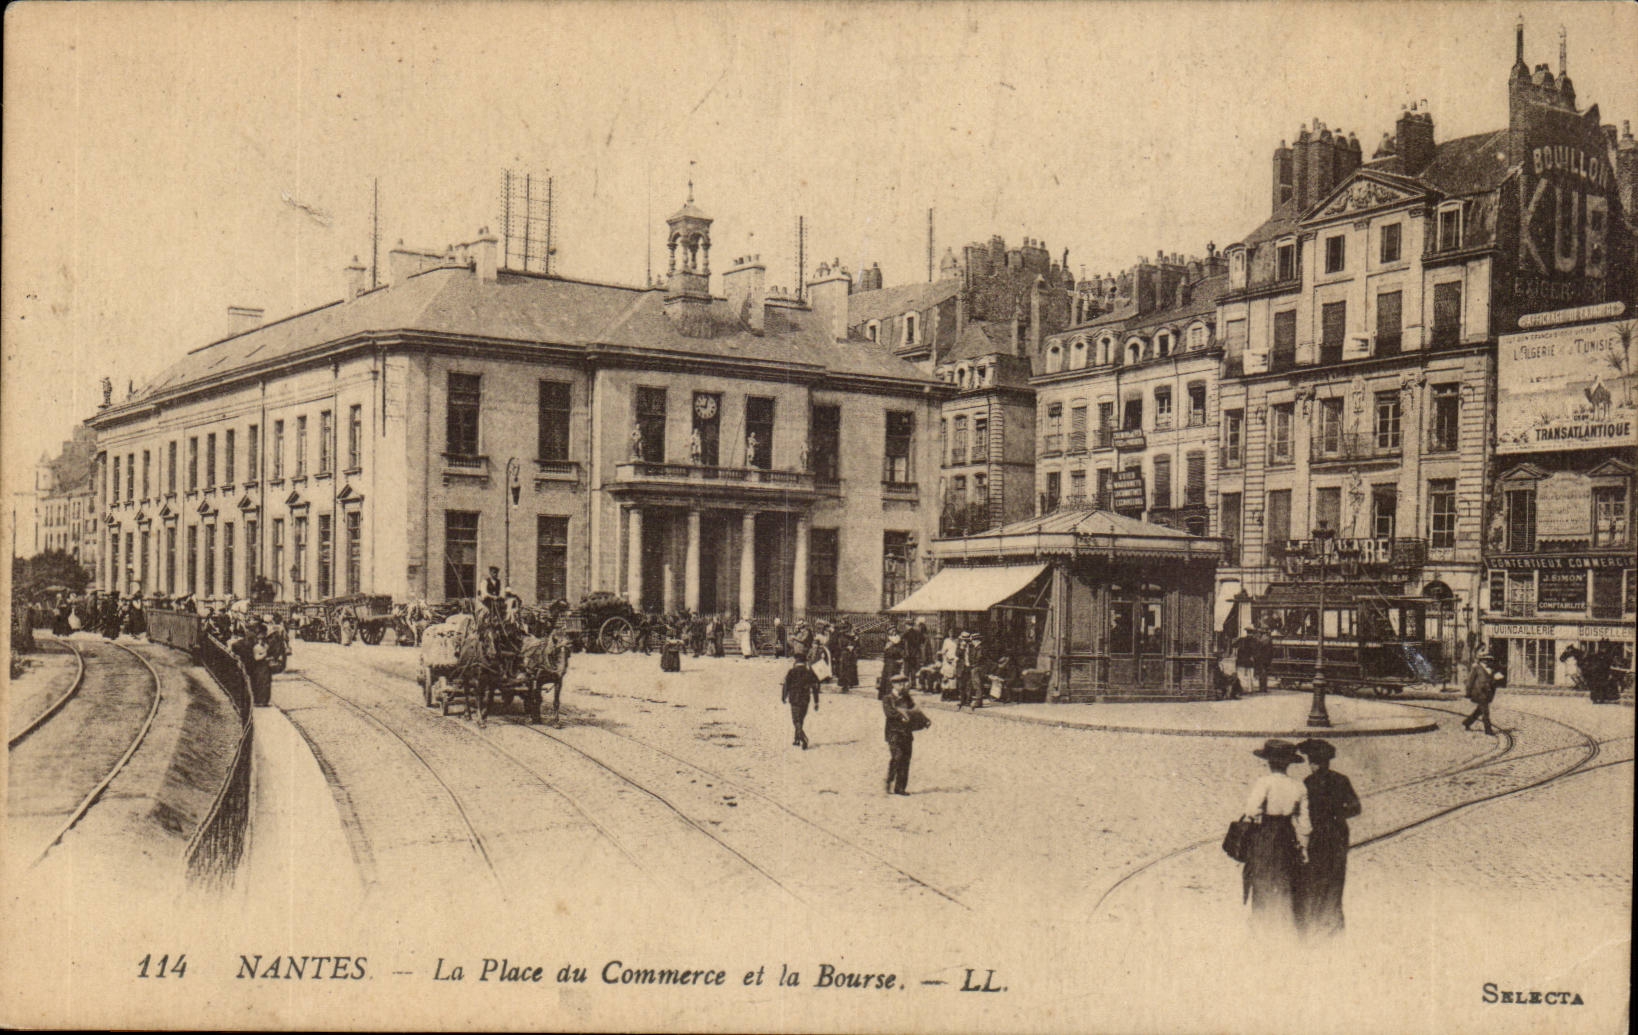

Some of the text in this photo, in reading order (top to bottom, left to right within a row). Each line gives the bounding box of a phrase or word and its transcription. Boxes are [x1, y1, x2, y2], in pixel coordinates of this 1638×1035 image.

[1519, 178, 1608, 278] KUB
[1574, 338, 1614, 354] TUNISIE
[1536, 422, 1631, 442] TRANSATLANTIQUE
[1490, 557, 1562, 569] CONTENTIEUX
